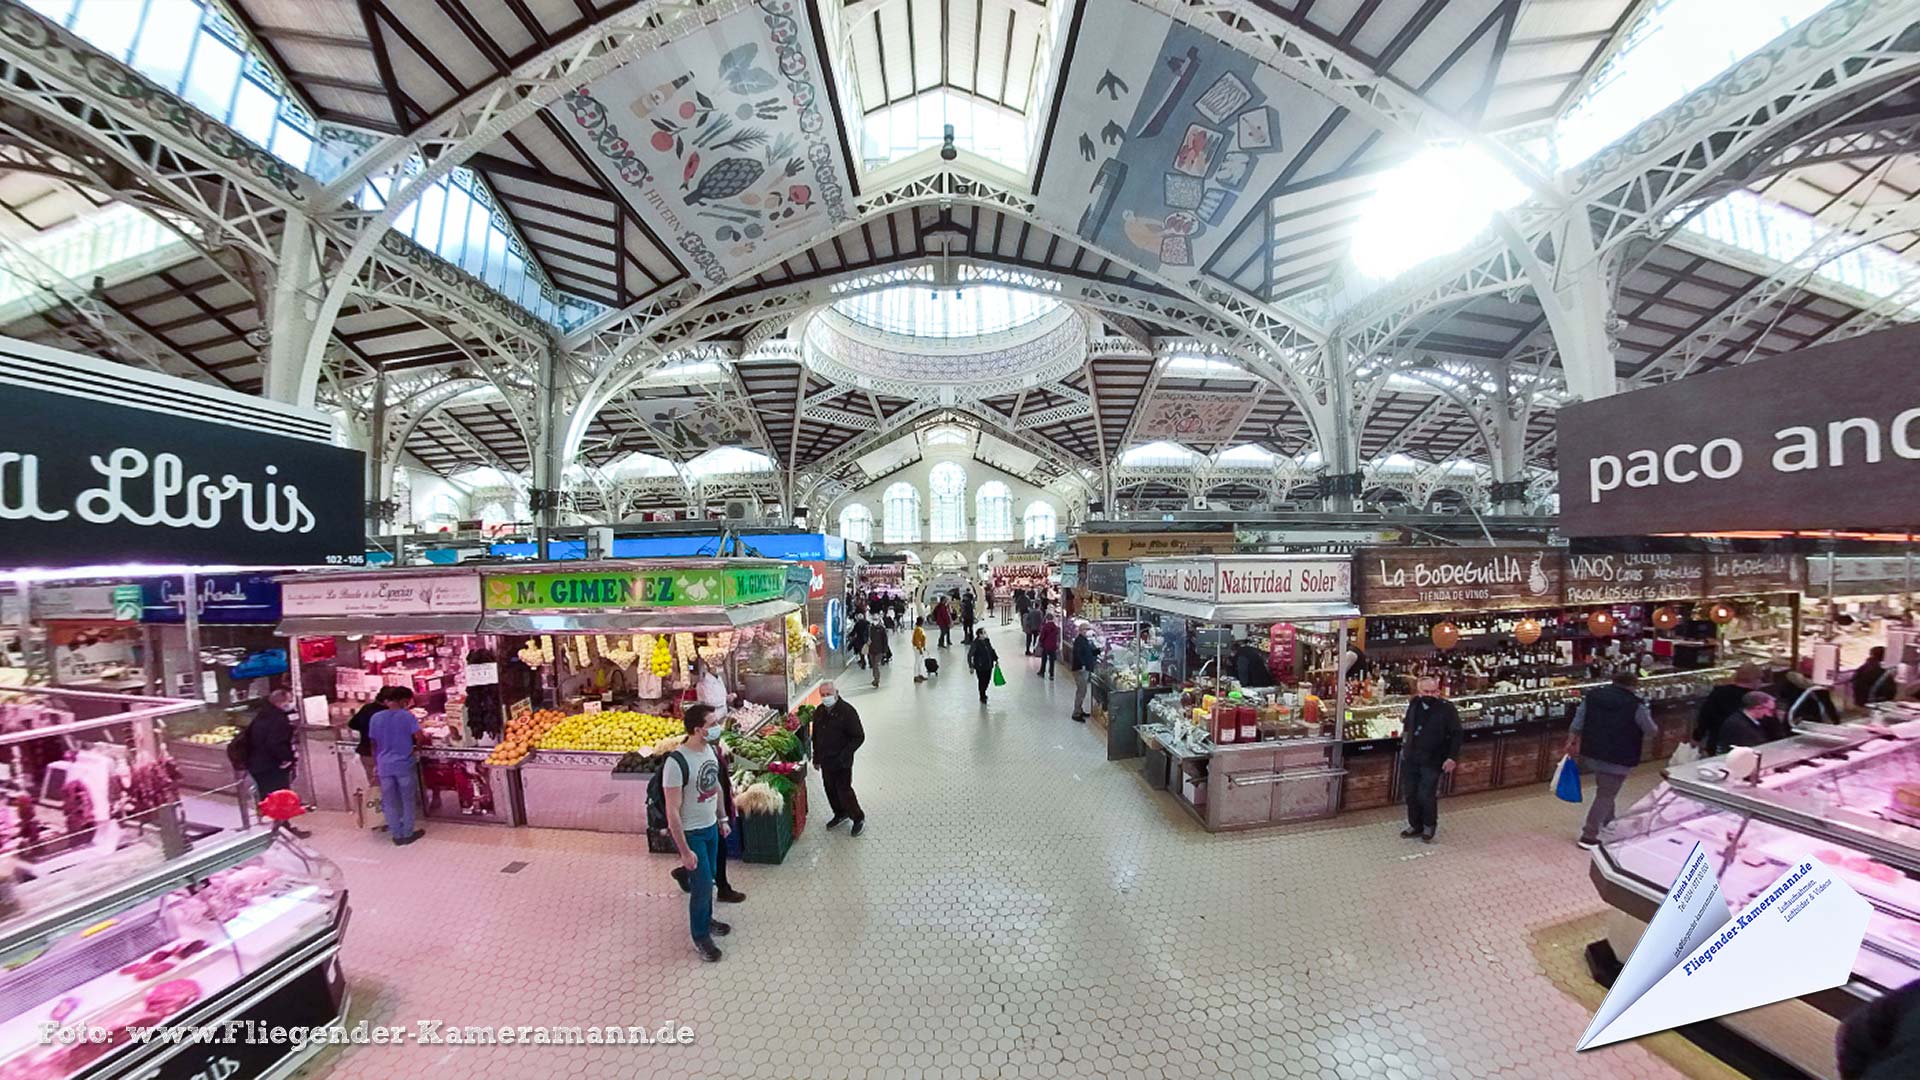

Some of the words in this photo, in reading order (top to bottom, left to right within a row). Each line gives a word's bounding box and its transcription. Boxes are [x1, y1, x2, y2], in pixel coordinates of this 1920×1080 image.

[1589, 437, 1743, 504] paco
[75, 447, 316, 533] Lloris
[1142, 568, 1178, 591] atividad
[1184, 568, 1214, 593] Soler
[1380, 559, 1405, 587] La
[1570, 555, 1614, 581] VINOS
[516, 581, 544, 604] M.
[551, 577, 675, 604] GIMENEZ
[1220, 570, 1293, 594] Natividad
[1300, 570, 1337, 592] Soler
[1453, 591, 1464, 600] DE
[1465, 590, 1489, 600] VINOS
